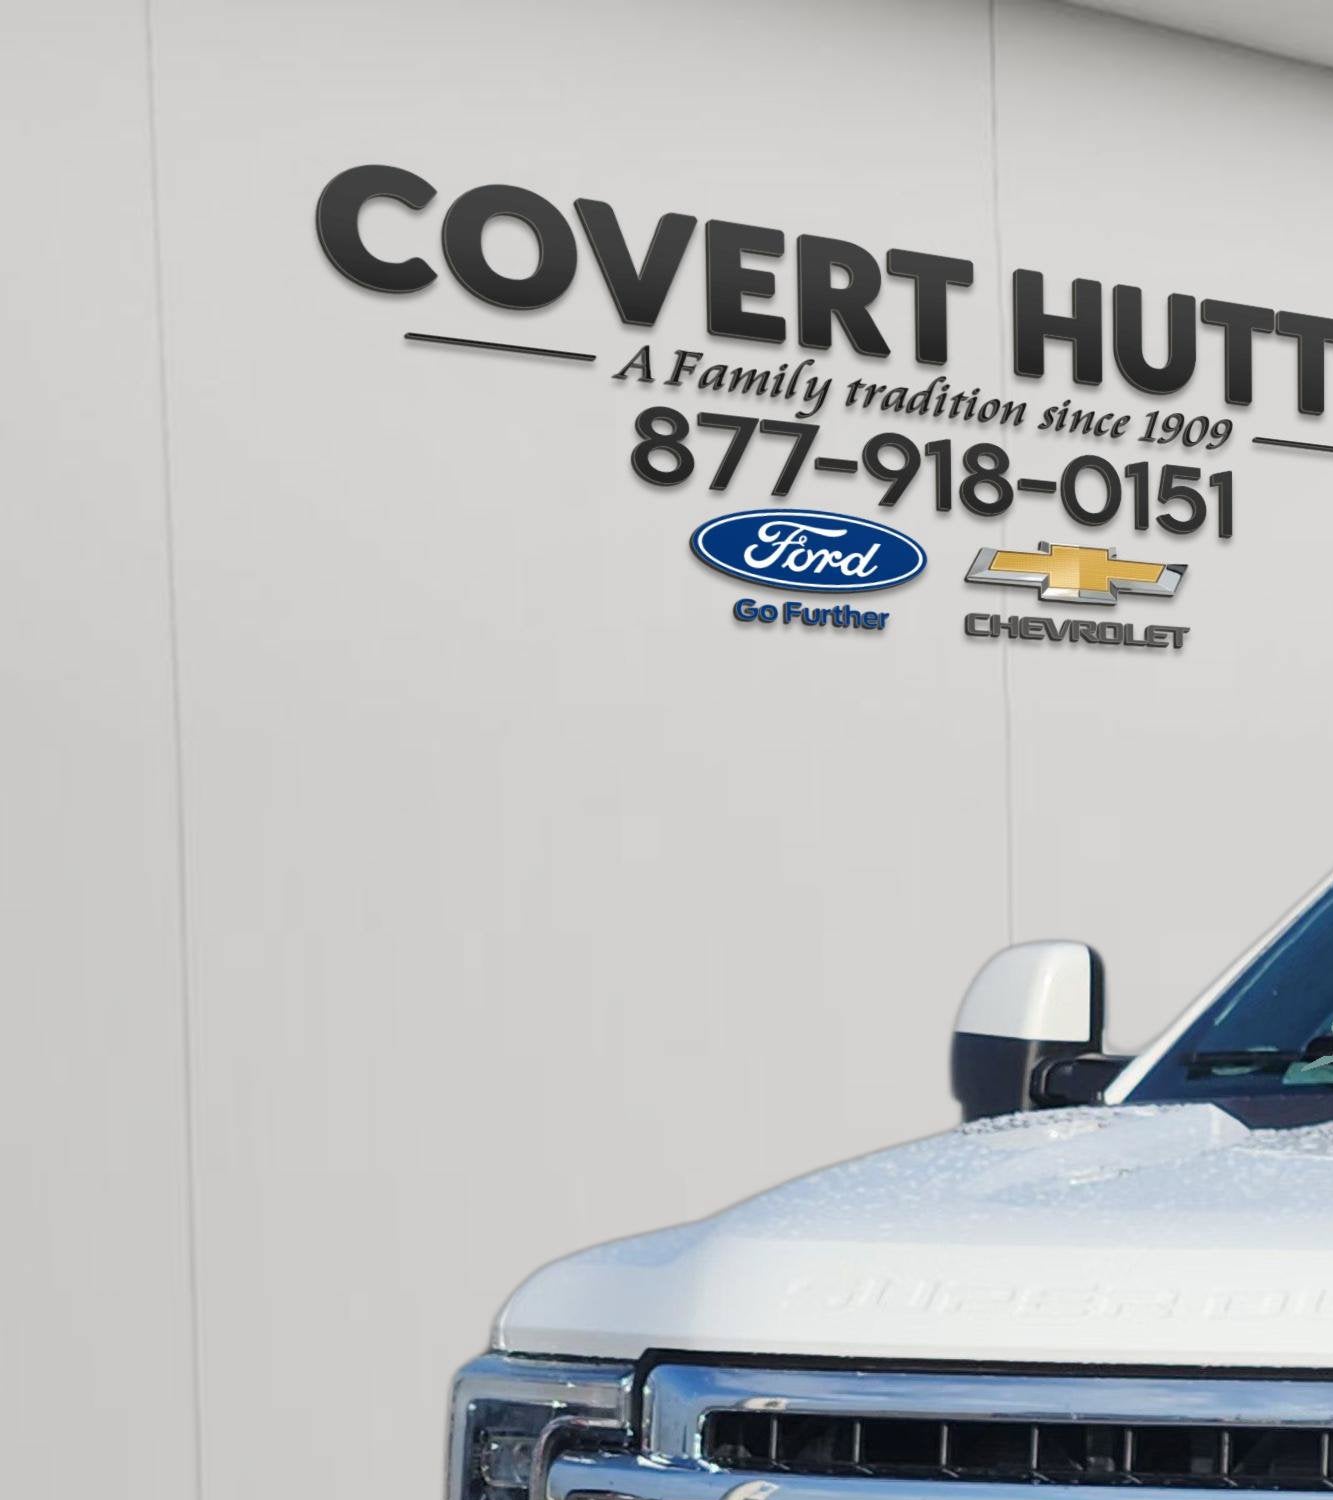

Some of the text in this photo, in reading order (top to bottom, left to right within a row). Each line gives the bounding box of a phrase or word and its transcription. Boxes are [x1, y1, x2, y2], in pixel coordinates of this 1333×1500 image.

[315, 164, 974, 367] COVERT
[612, 345, 1234, 450] A Family tradition since 1909
[629, 406, 1234, 541] 877-918-0151
[743, 519, 883, 579] Ford
[733, 598, 890, 631] Go Further
[963, 611, 1191, 650] CHEVROLET
